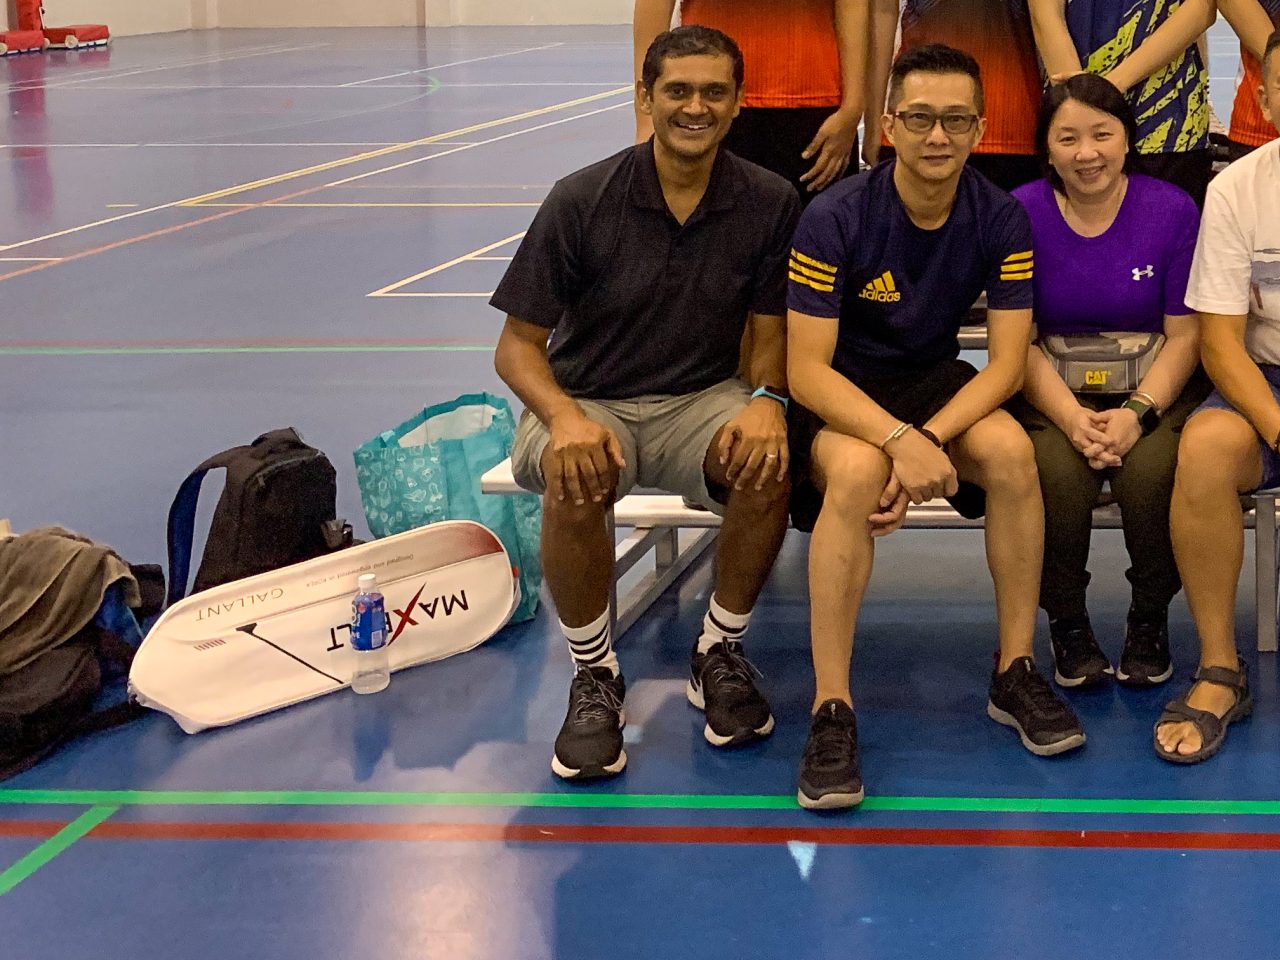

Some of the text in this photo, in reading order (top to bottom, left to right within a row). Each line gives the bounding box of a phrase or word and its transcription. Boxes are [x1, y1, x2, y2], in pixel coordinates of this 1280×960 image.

[1085, 370, 1108, 385] CAT
[195, 586, 285, 622] GALLANT
[326, 580, 470, 652] MAXLT
